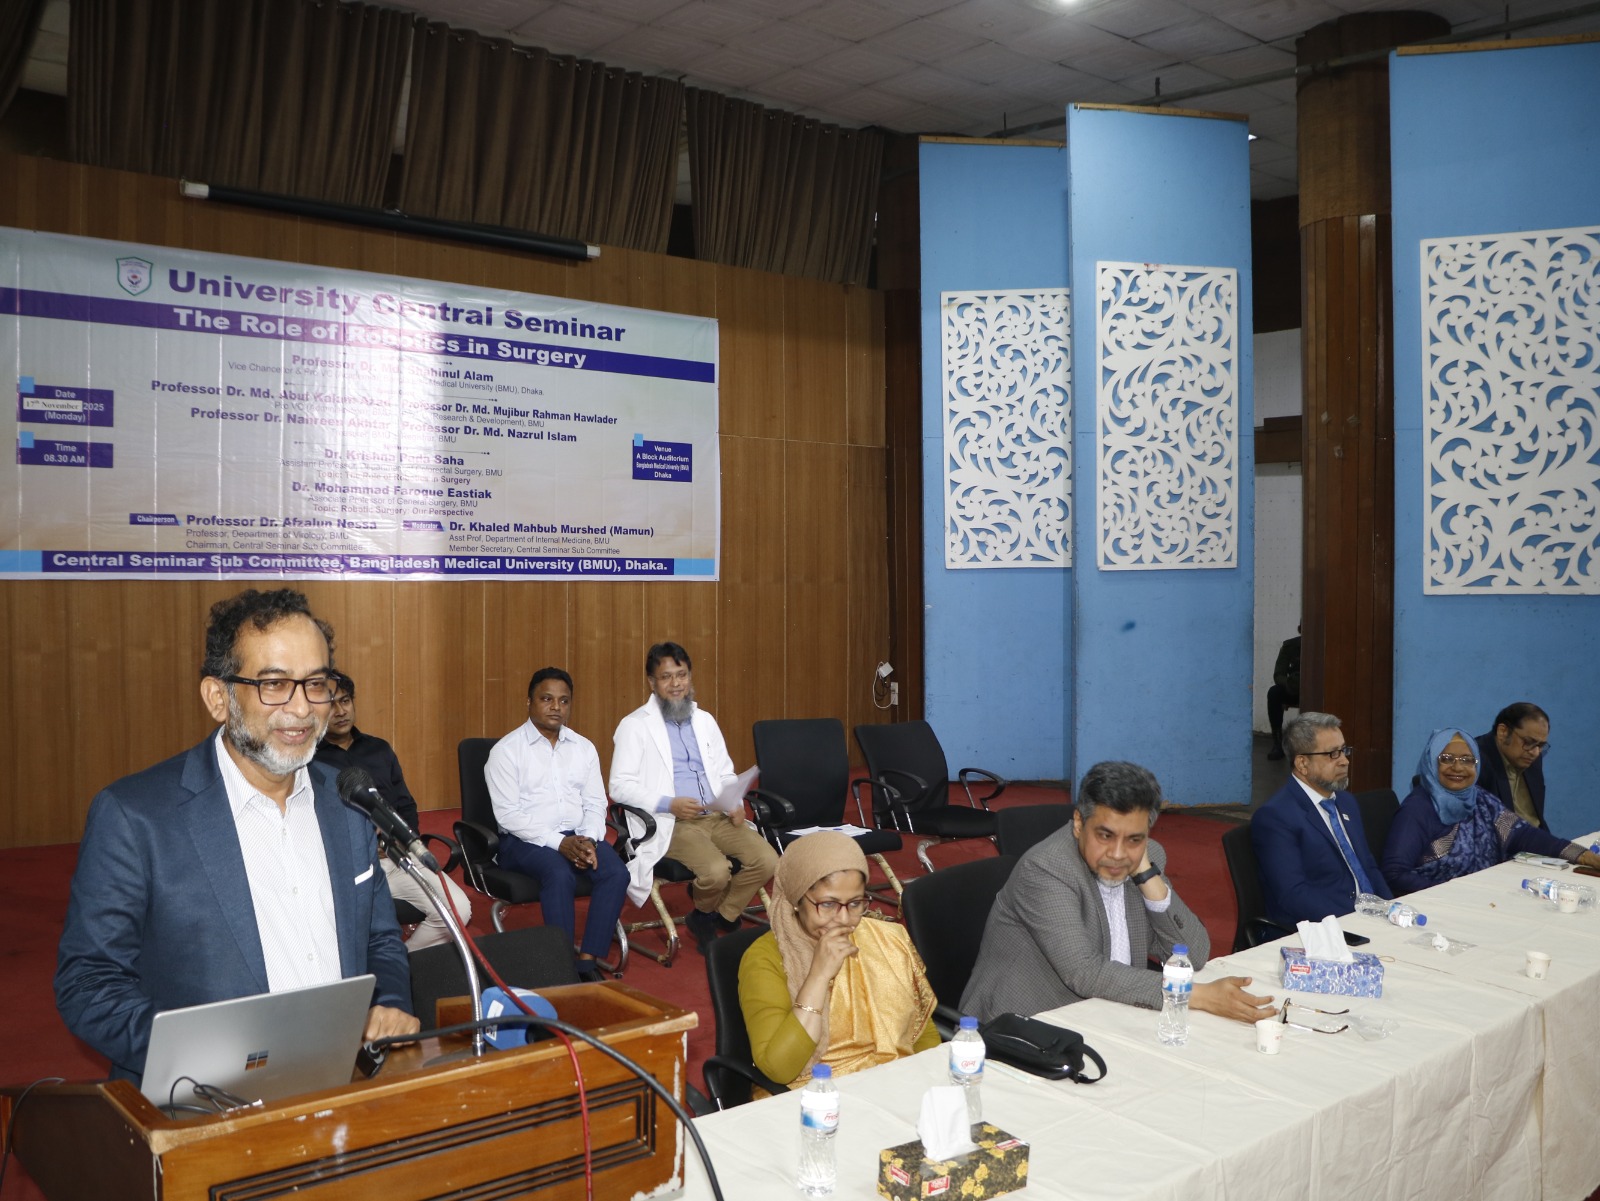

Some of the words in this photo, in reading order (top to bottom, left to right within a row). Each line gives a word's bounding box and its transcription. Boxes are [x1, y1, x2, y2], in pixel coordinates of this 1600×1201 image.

[169, 269, 360, 315] University
[372, 293, 493, 326] Central
[504, 309, 626, 342] Seminar
[173, 308, 230, 330] The
[240, 315, 302, 337] Role
[311, 323, 339, 340] of
[348, 325, 459, 353] Robotics
[468, 338, 489, 356] in
[497, 341, 587, 369] Surgery
[292, 354, 356, 371] Professor
[408, 365, 460, 380] Shahinul
[464, 370, 494, 382] Alam
[228, 361, 247, 371] Vice
[429, 378, 457, 389] Medical
[459, 381, 494, 393] University
[495, 385, 520, 395] (BMU),
[521, 387, 545, 396] Dhaka.
[55, 389, 76, 399] Date
[151, 380, 222, 395] Professor
[226, 385, 245, 397] Dr.
[250, 387, 274, 399] Md.
[41, 401, 79, 410] November
[83, 402, 104, 412] 2025
[274, 401, 288, 410] Po
[44, 411, 86, 423] (Monday)
[191, 407, 259, 422] Professor
[264, 412, 282, 422] Dr.
[402, 400, 452, 413] Professor
[456, 403, 469, 413] Dr.
[472, 404, 490, 415] Md.
[493, 406, 530, 419] Mujibur
[533, 409, 571, 421] Rahman
[574, 413, 618, 425] Hawlader
[476, 417, 527, 428] Development),
[528, 419, 545, 428] BMU
[401, 421, 460, 435] Professor
[463, 426, 480, 436] Dr.
[483, 427, 504, 437] Md.
[507, 429, 544, 440] Nazrul
[547, 431, 577, 442] Islam
[55, 443, 77, 452] Time
[654, 445, 672, 453] Venue
[44, 454, 68, 463] 08.30
[70, 455, 85, 463] AM
[346, 449, 397, 462] Krishna
[434, 454, 465, 466] Saha
[659, 454, 689, 462] Auditorium
[454, 467, 484, 477] Surgery,
[485, 469, 503, 477] BMU
[654, 471, 672, 479] Dhaka
[441, 476, 471, 485] Surgery
[292, 481, 310, 492] Dr.
[315, 482, 389, 495] Mohammad
[393, 485, 444, 498] Faroque
[447, 488, 492, 499] Eastiak
[428, 499, 459, 508] Surgery,
[428, 508, 474, 517] Perspective
[186, 514, 254, 527] Professor
[260, 516, 278, 527] Dr.
[337, 519, 377, 529] Nessa
[186, 528, 229, 538] Professor,
[449, 521, 465, 532] Dr.
[469, 522, 510, 533] Khaled
[513, 523, 557, 533] Mahbub
[560, 524, 607, 535] Murshed
[609, 525, 654, 537] (Mamun)
[186, 540, 231, 550] Chairman,
[233, 541, 263, 550] Central
[449, 534, 465, 542] Asst
[485, 535, 526, 544] Department
[527, 535, 534, 543] of
[535, 536, 560, 544] Internal
[561, 537, 593, 546] Medicine,
[594, 537, 610, 545] BMU
[449, 544, 479, 552] Member
[480, 545, 515, 555] Secretary,
[516, 546, 541, 554] Central
[542, 546, 570, 554] Seminar
[571, 547, 585, 555] Sub
[586, 547, 620, 555] Committee
[53, 553, 123, 567] Central
[130, 554, 205, 567] Seminar
[210, 555, 243, 567] Sub
[248, 555, 345, 569] Committee,
[350, 556, 440, 570] Bangladesh
[444, 558, 501, 569] Medical
[505, 558, 574, 572] University
[578, 559, 621, 573] (BMU),
[625, 560, 667, 571] Dhaka.
